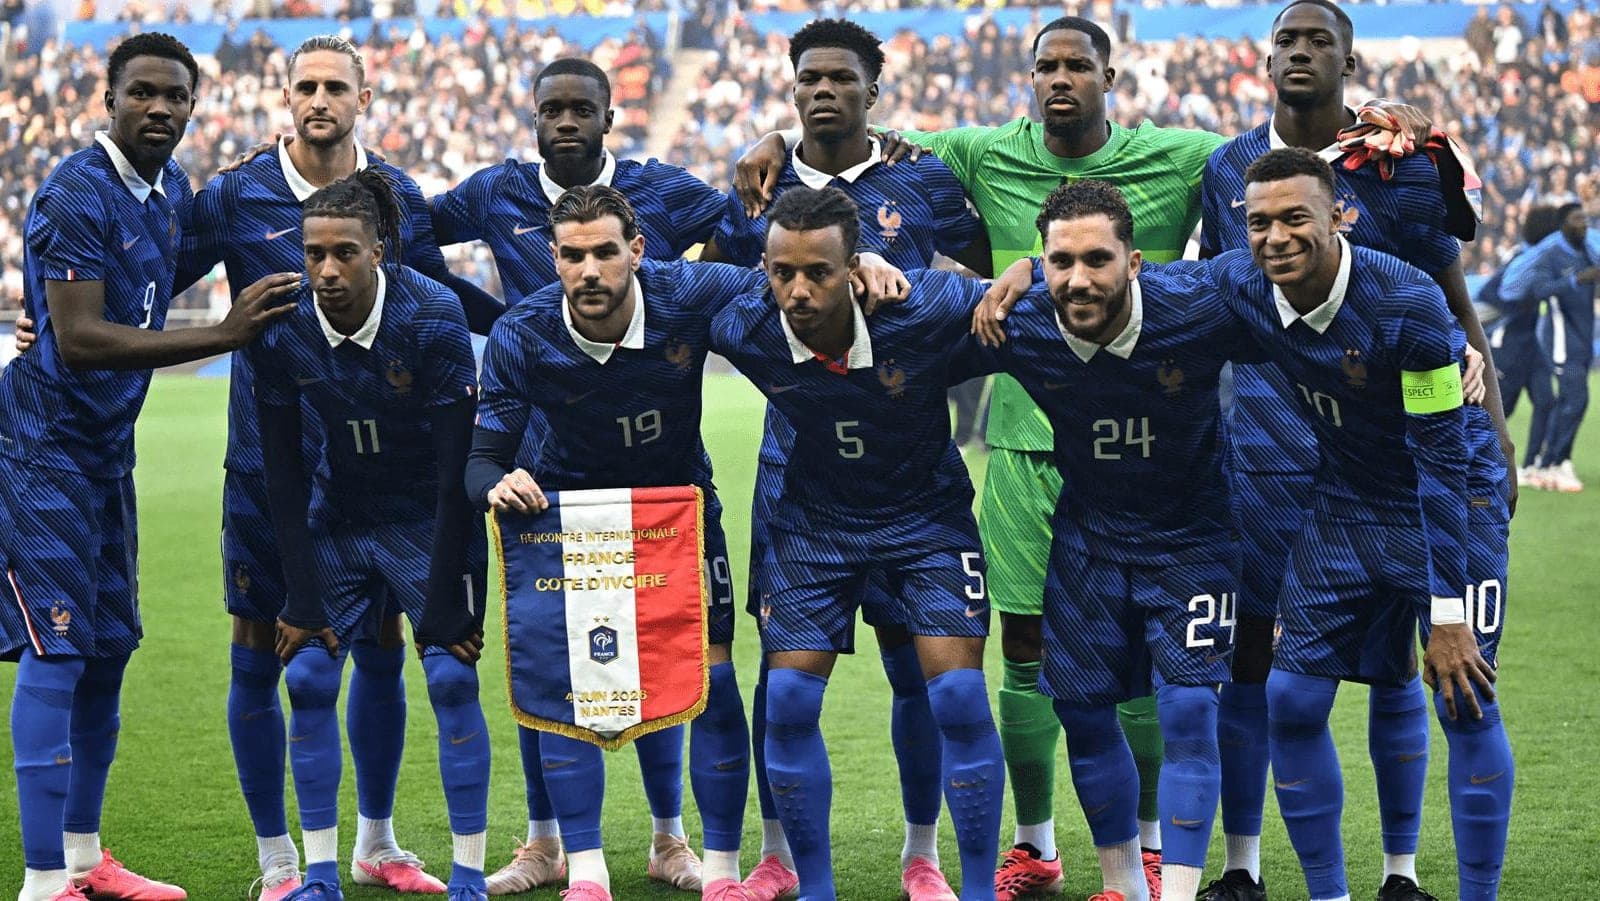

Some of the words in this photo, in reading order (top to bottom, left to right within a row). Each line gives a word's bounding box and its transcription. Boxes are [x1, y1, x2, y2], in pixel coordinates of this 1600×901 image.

[139, 281, 156, 329] 9
[346, 420, 380, 454] 11
[616, 409, 662, 447] 19
[835, 421, 864, 459] 5
[1093, 417, 1155, 460] 24
[520, 532, 583, 543] RENCONTRE
[586, 528, 678, 543] INTERNATIONALE
[562, 551, 637, 566] FRANCE
[960, 552, 985, 599] 5
[535, 577, 584, 592] COTE
[588, 574, 667, 591] D'IVOIRE
[1186, 592, 1237, 648] 24
[1465, 579, 1501, 634] 10
[565, 692, 574, 703] 4
[578, 690, 607, 702] JUIN
[610, 689, 648, 701] 2026
[580, 706, 636, 717] NANTES
